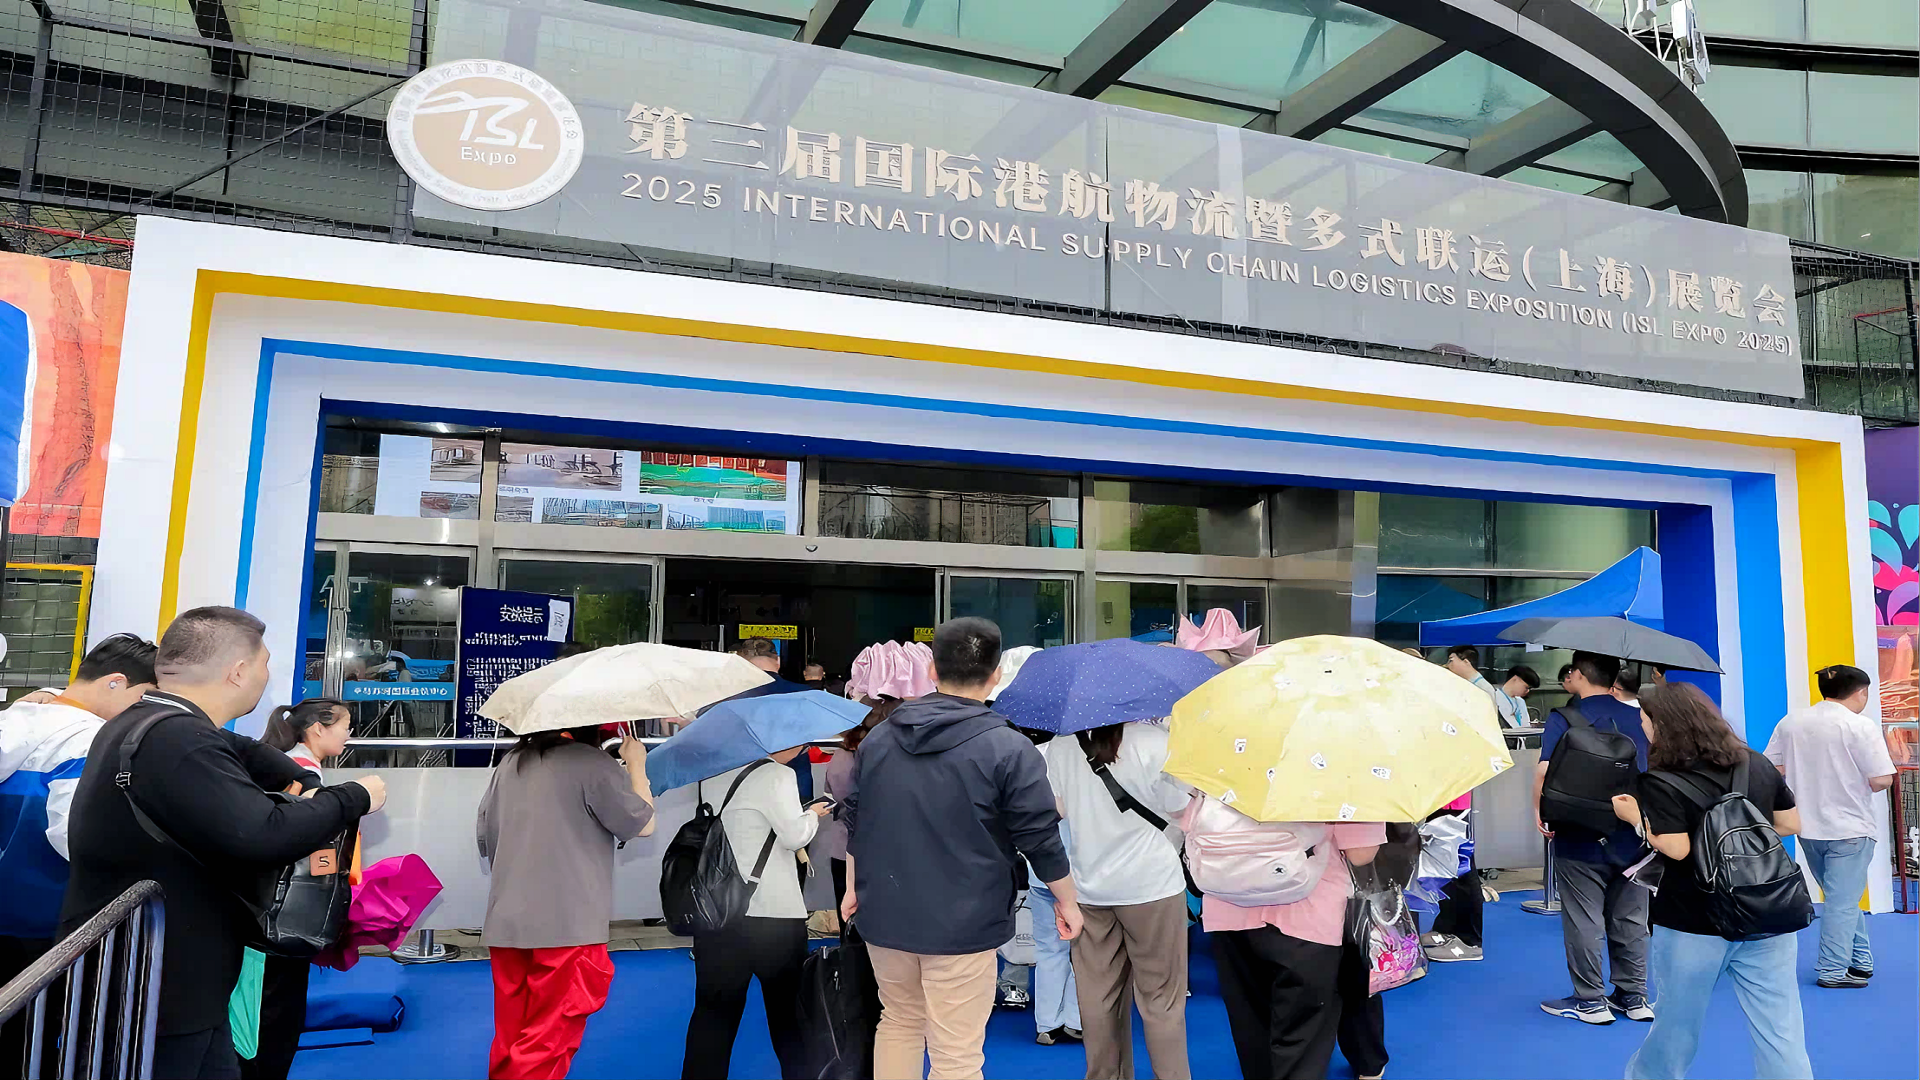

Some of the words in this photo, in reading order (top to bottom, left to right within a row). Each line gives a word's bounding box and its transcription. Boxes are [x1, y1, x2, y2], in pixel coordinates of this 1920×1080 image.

[461, 146, 517, 166] Expo
[620, 172, 723, 209] 2025
[743, 186, 1047, 252] INTERNATIONAL
[1061, 233, 1193, 270] SUPPLY
[1206, 251, 1300, 284] CHAIN
[1312, 265, 1457, 306] LOGISTICS
[1466, 288, 1614, 329] EXPOSITION
[1621, 311, 1664, 338] (ISL
[1672, 320, 1728, 345] EXPO
[1737, 330, 1793, 356] 2025)
